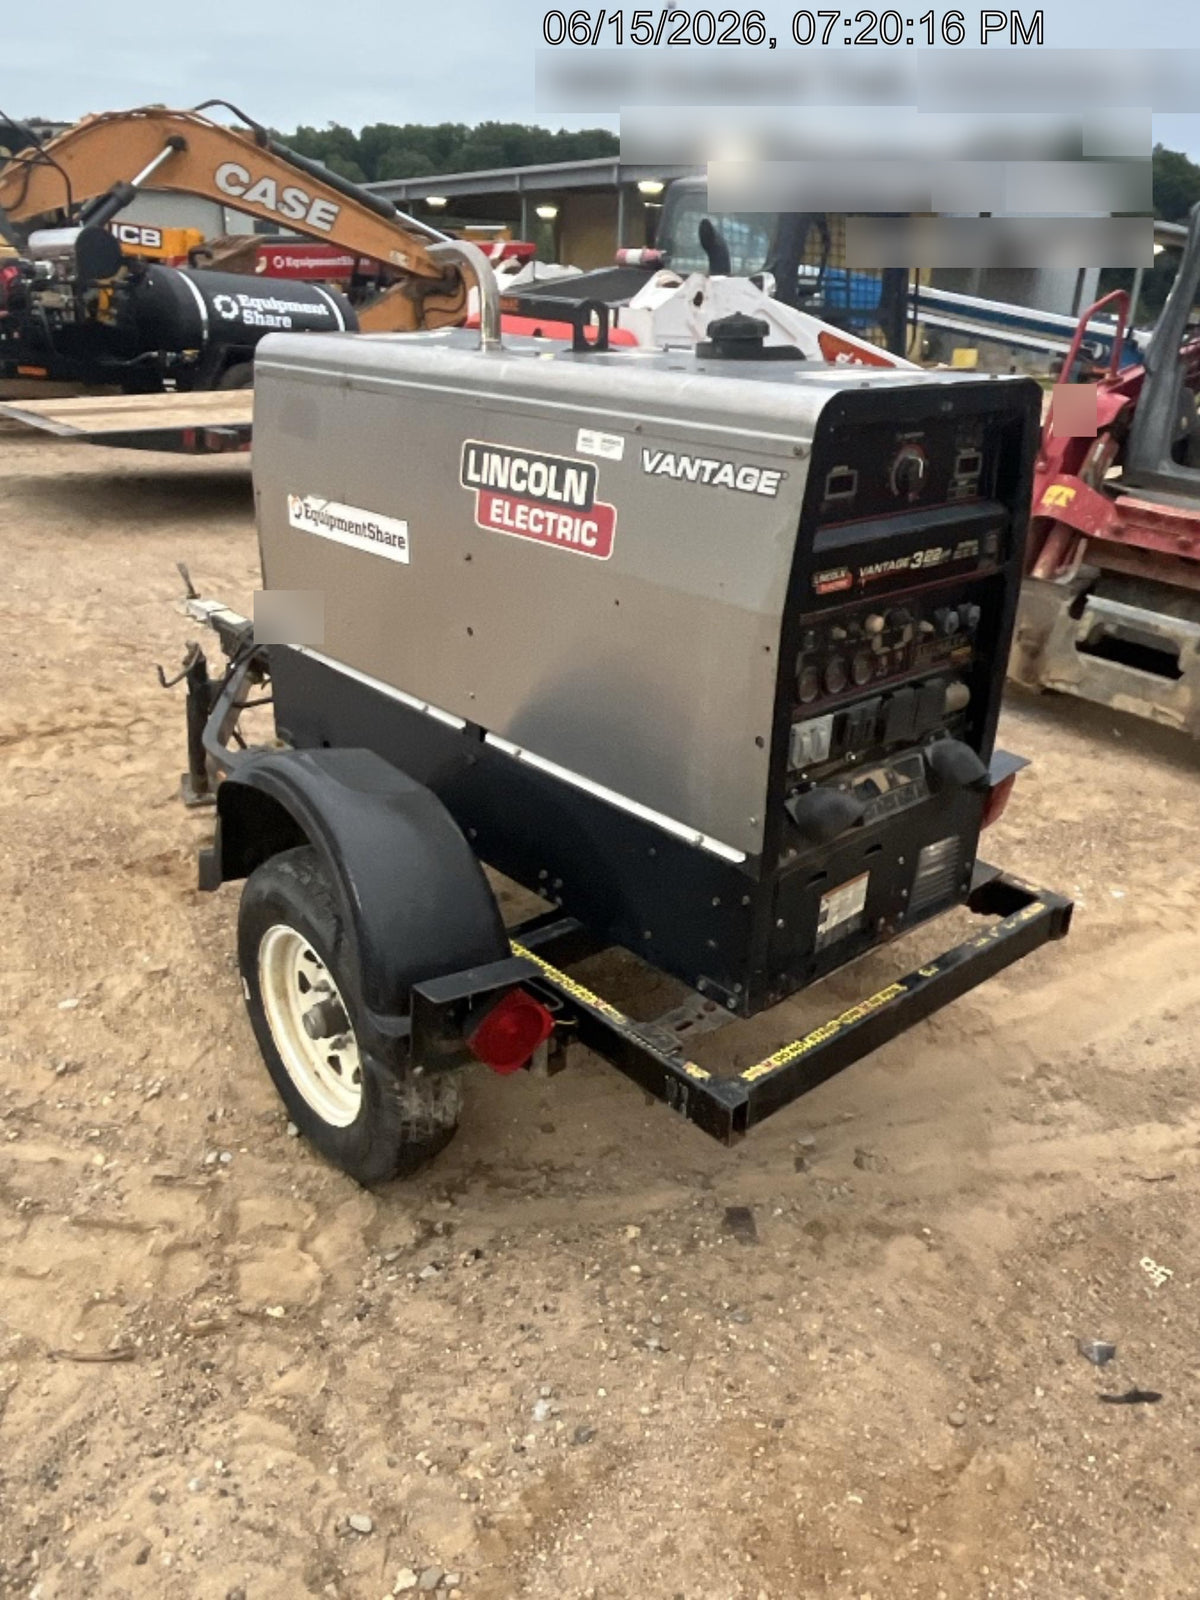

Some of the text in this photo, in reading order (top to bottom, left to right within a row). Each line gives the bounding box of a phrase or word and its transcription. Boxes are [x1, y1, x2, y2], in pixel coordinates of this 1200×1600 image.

[214, 162, 340, 232] CASE
[285, 256, 371, 269] EquipmentShre
[236, 294, 329, 316] Equipment
[242, 308, 292, 328] Share
[467, 449, 588, 506] LINCOLN
[642, 448, 784, 498] VANTAGE
[304, 503, 406, 550] EquipmentShare
[490, 498, 598, 547] ELECTRIC
[859, 556, 910, 577] VANTAGE
